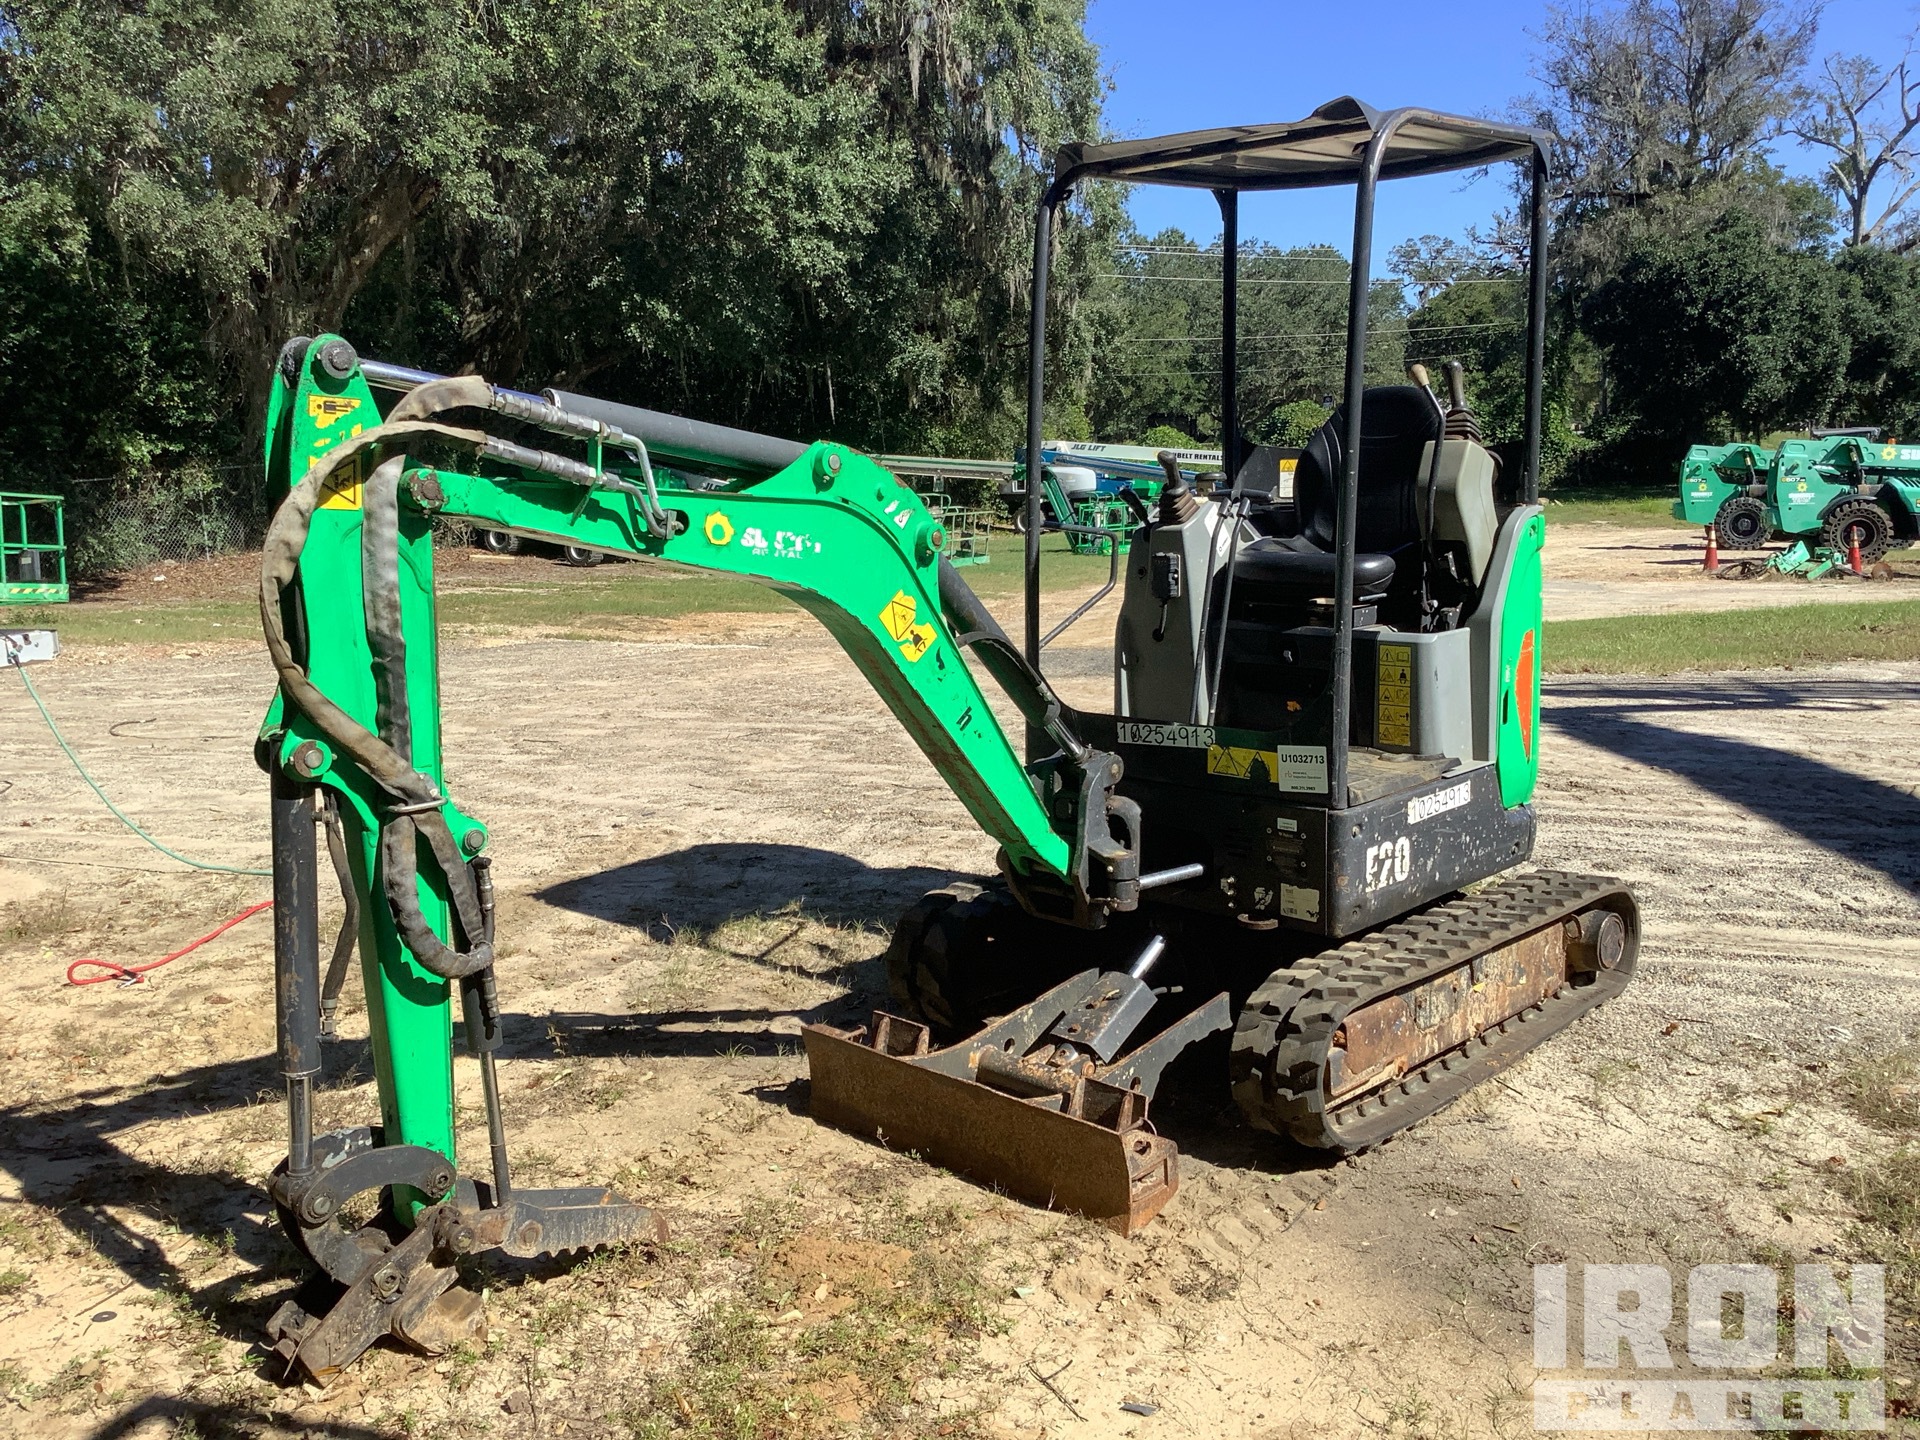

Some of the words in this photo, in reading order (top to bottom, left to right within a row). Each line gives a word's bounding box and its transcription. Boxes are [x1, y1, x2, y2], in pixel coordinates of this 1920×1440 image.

[1071, 443, 1087, 451] JLG
[1088, 444, 1107, 452] LIFT
[1119, 723, 1215, 747] 10254913
[1281, 753, 1325, 765] U1032713
[1411, 783, 1471, 822] 10254913
[1365, 835, 1411, 893] E20
